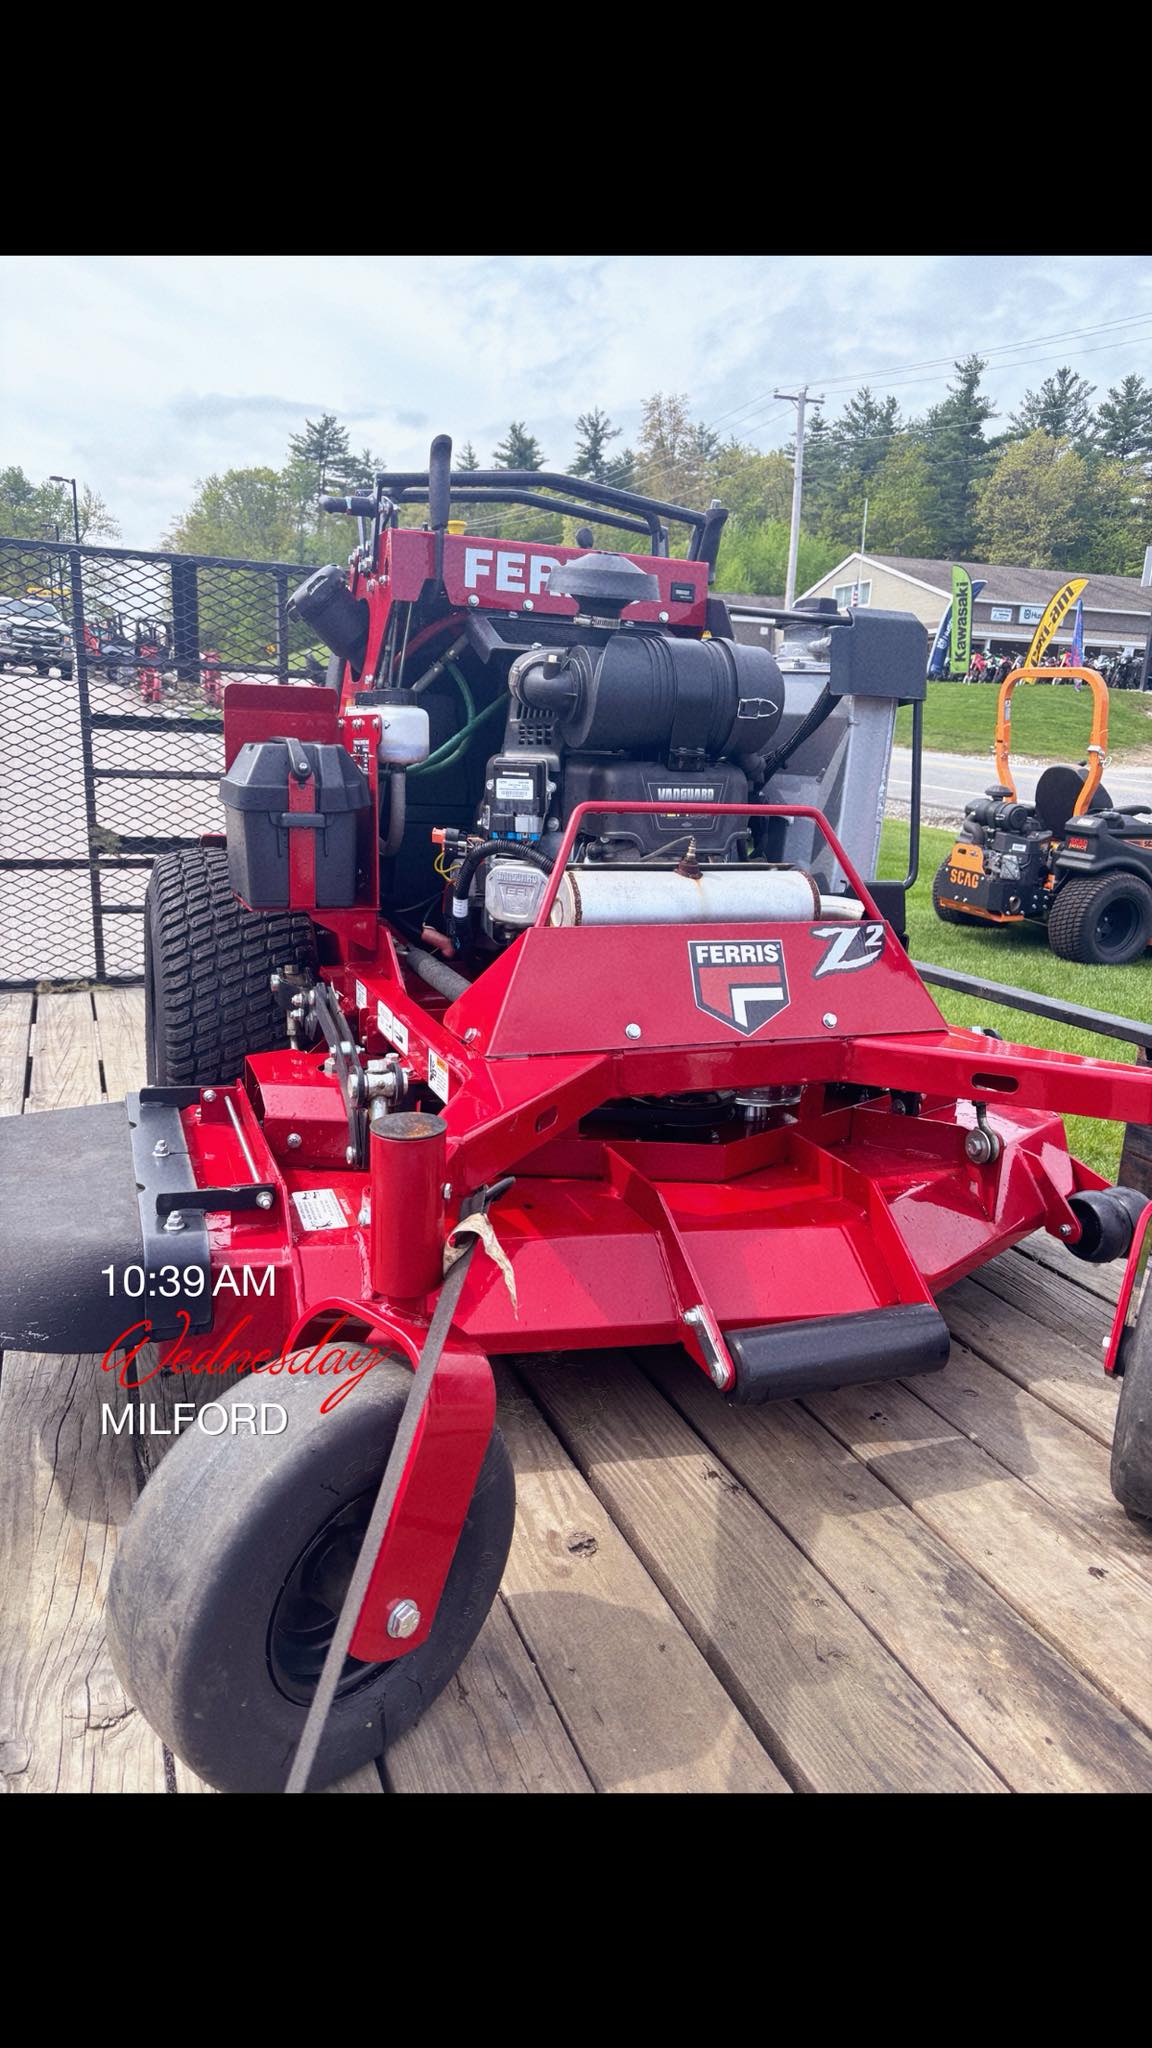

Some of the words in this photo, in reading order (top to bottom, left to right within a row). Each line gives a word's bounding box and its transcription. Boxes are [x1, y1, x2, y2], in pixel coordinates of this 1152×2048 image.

[464, 547, 573, 598] FER
[955, 582, 969, 662] Kawasaki
[658, 788, 715, 801] VANGUARD
[950, 868, 979, 889] SCAG
[695, 945, 779, 964] FERRIS
